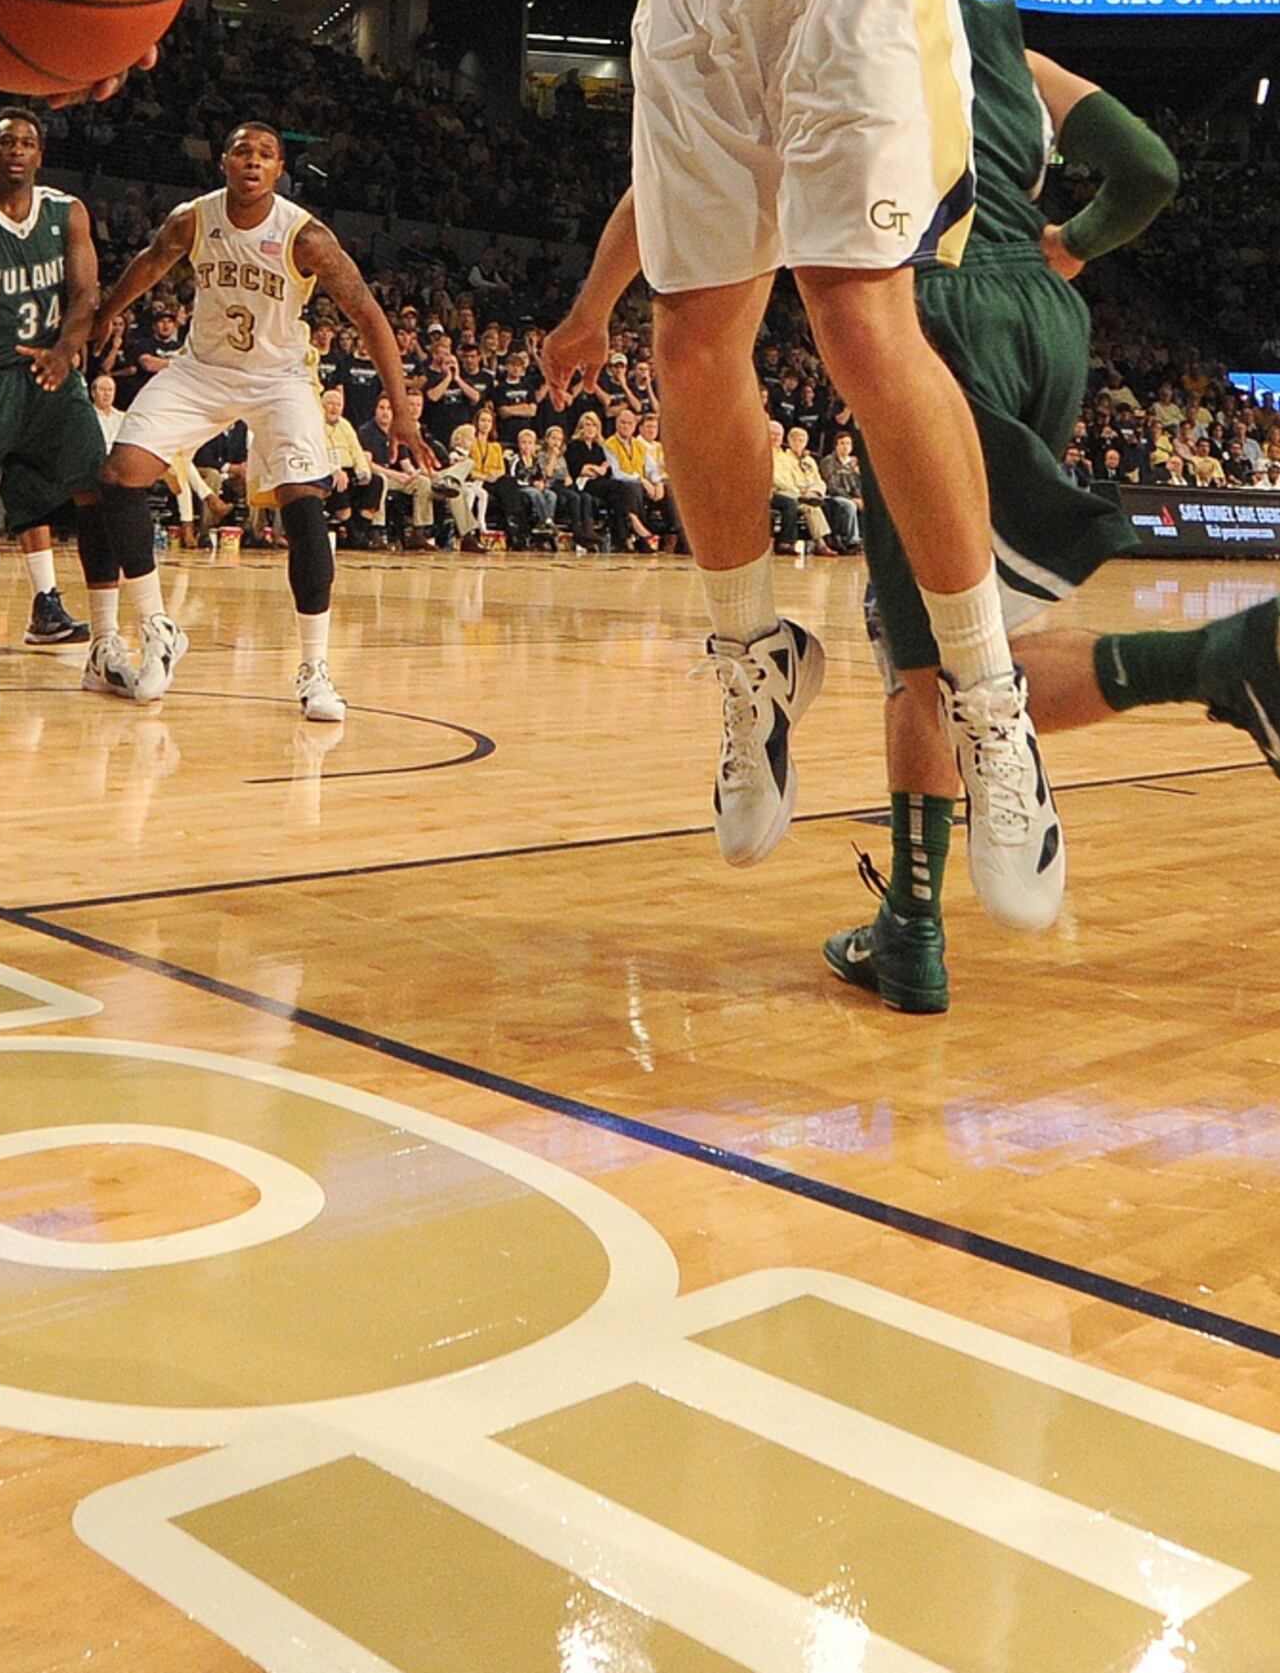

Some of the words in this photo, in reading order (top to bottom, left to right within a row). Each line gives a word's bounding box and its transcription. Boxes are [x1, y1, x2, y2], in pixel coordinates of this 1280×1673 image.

[869, 199, 912, 236] GT
[197, 262, 285, 302] TECH
[18, 294, 61, 340] 34
[226, 305, 254, 352] 3
